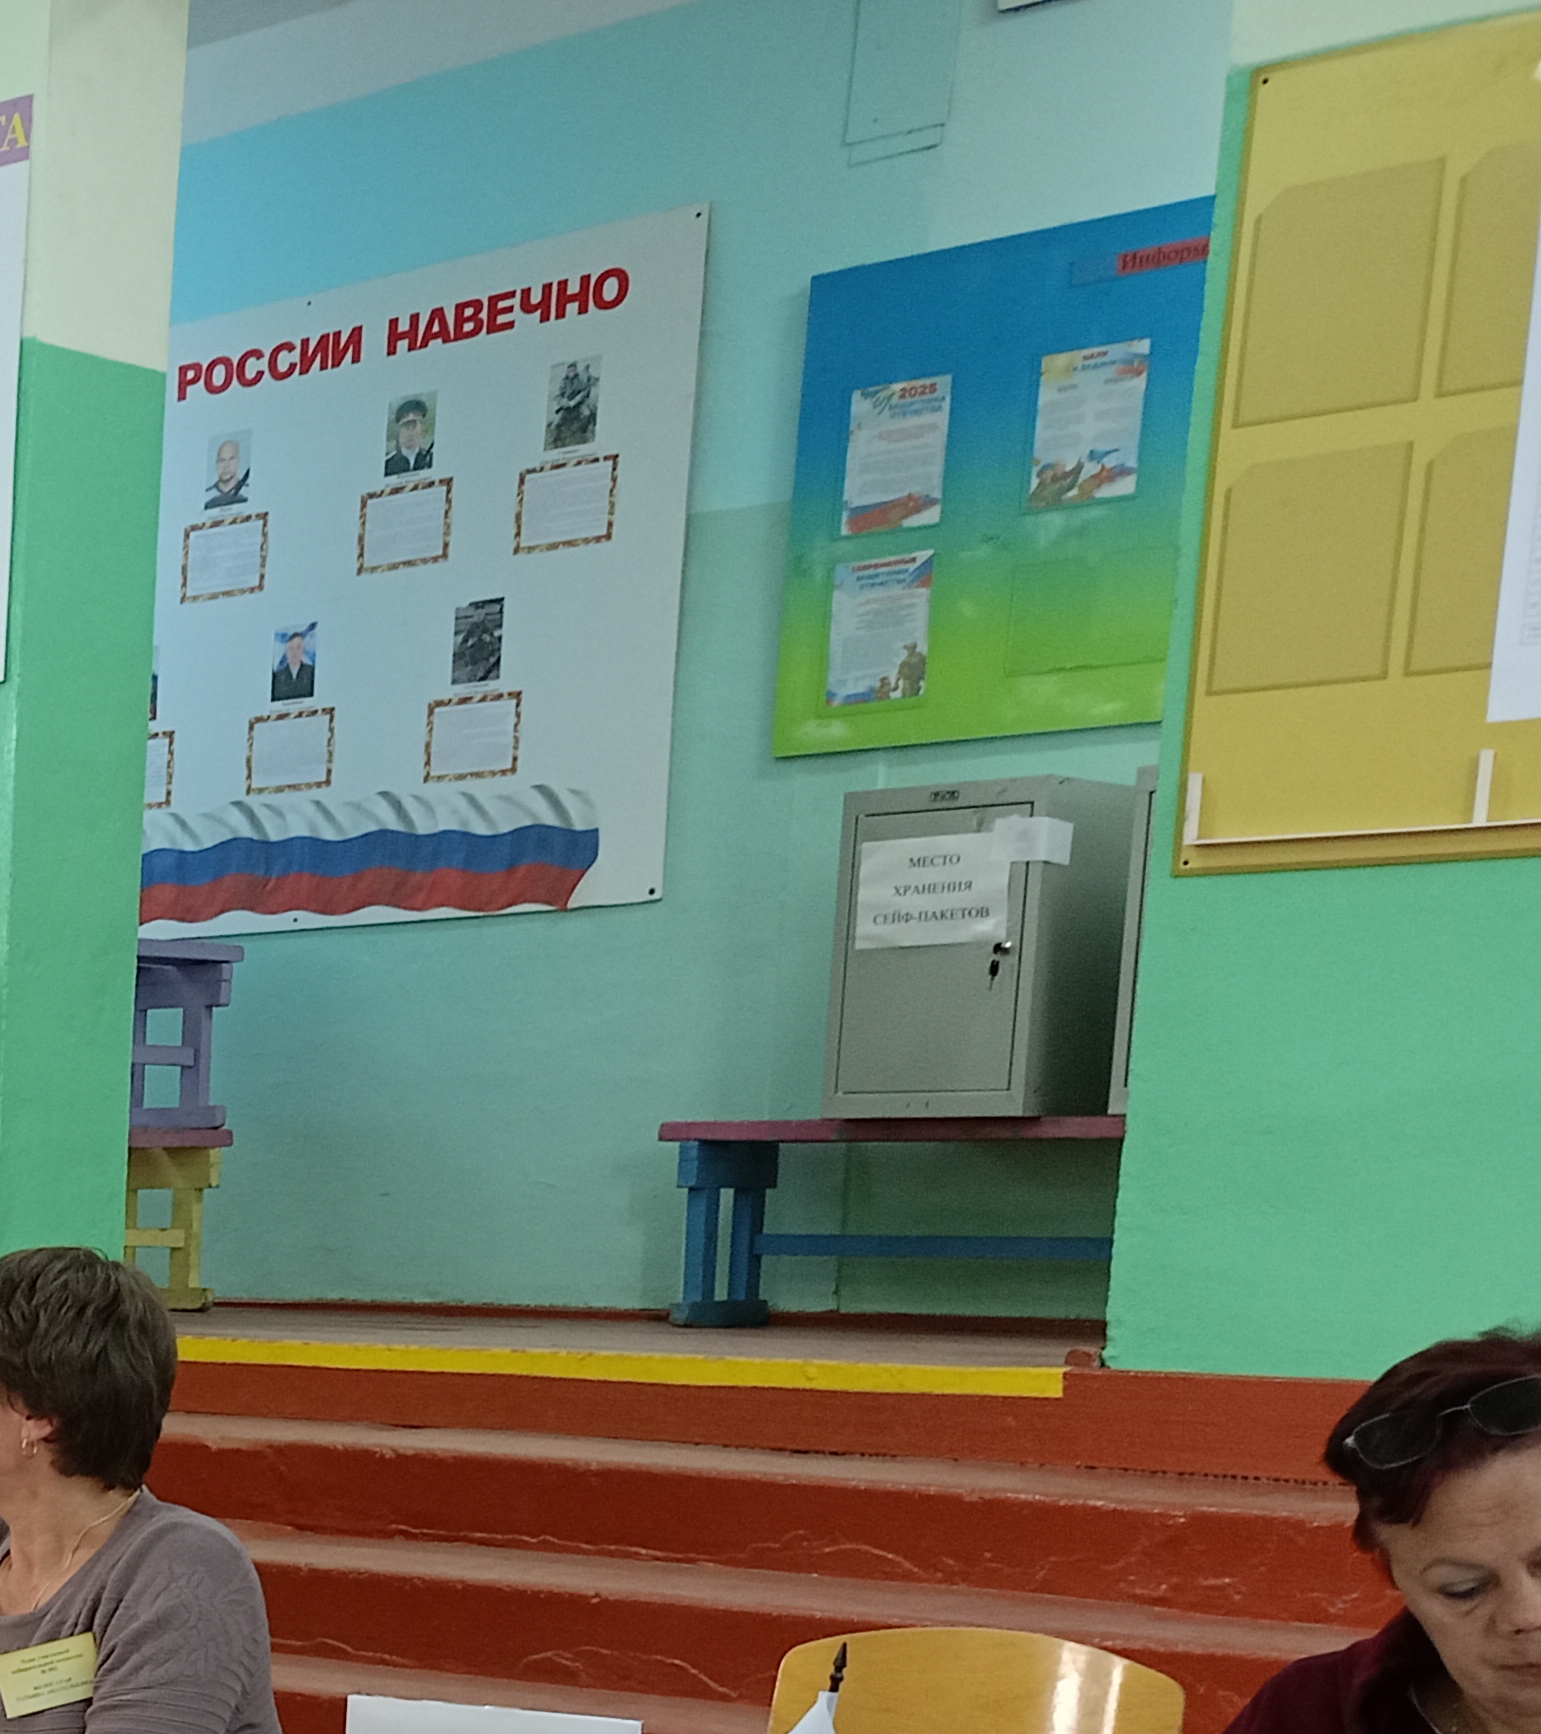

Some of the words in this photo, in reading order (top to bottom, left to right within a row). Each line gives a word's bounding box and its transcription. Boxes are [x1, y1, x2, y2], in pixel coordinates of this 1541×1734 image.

[177, 324, 363, 402] РОССИИ
[385, 266, 630, 357] НАВЕЧНО
[898, 382, 938, 400] 2025
[908, 854, 961, 869] МЕСТО
[892, 880, 973, 898] ХРАНЕНИЯ
[872, 906, 990, 926] СЕЙФ-ПАКЕТОВ
